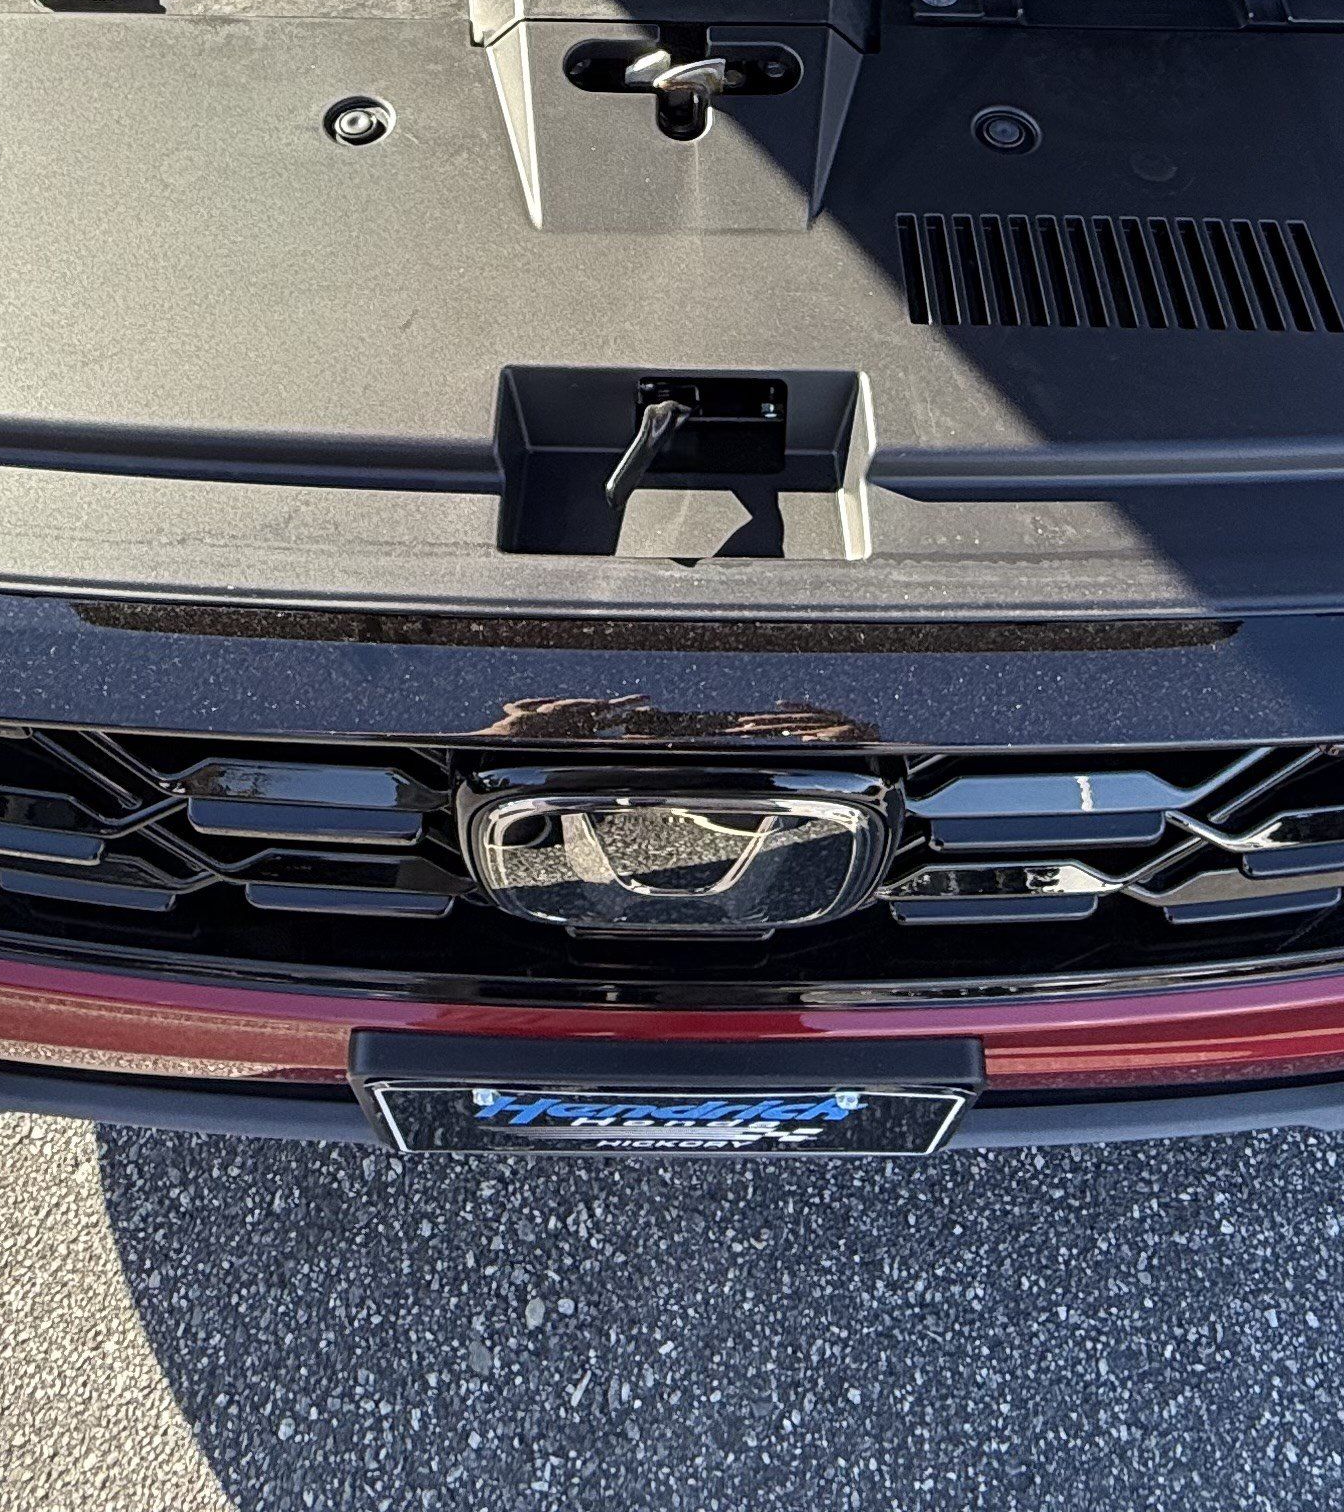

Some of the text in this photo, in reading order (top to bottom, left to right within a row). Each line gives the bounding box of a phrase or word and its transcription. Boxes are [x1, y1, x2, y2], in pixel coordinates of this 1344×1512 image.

[474, 1096, 868, 1124] Hendrick
[570, 1117, 781, 1130] Honda
[595, 1139, 755, 1149] HICKORY
